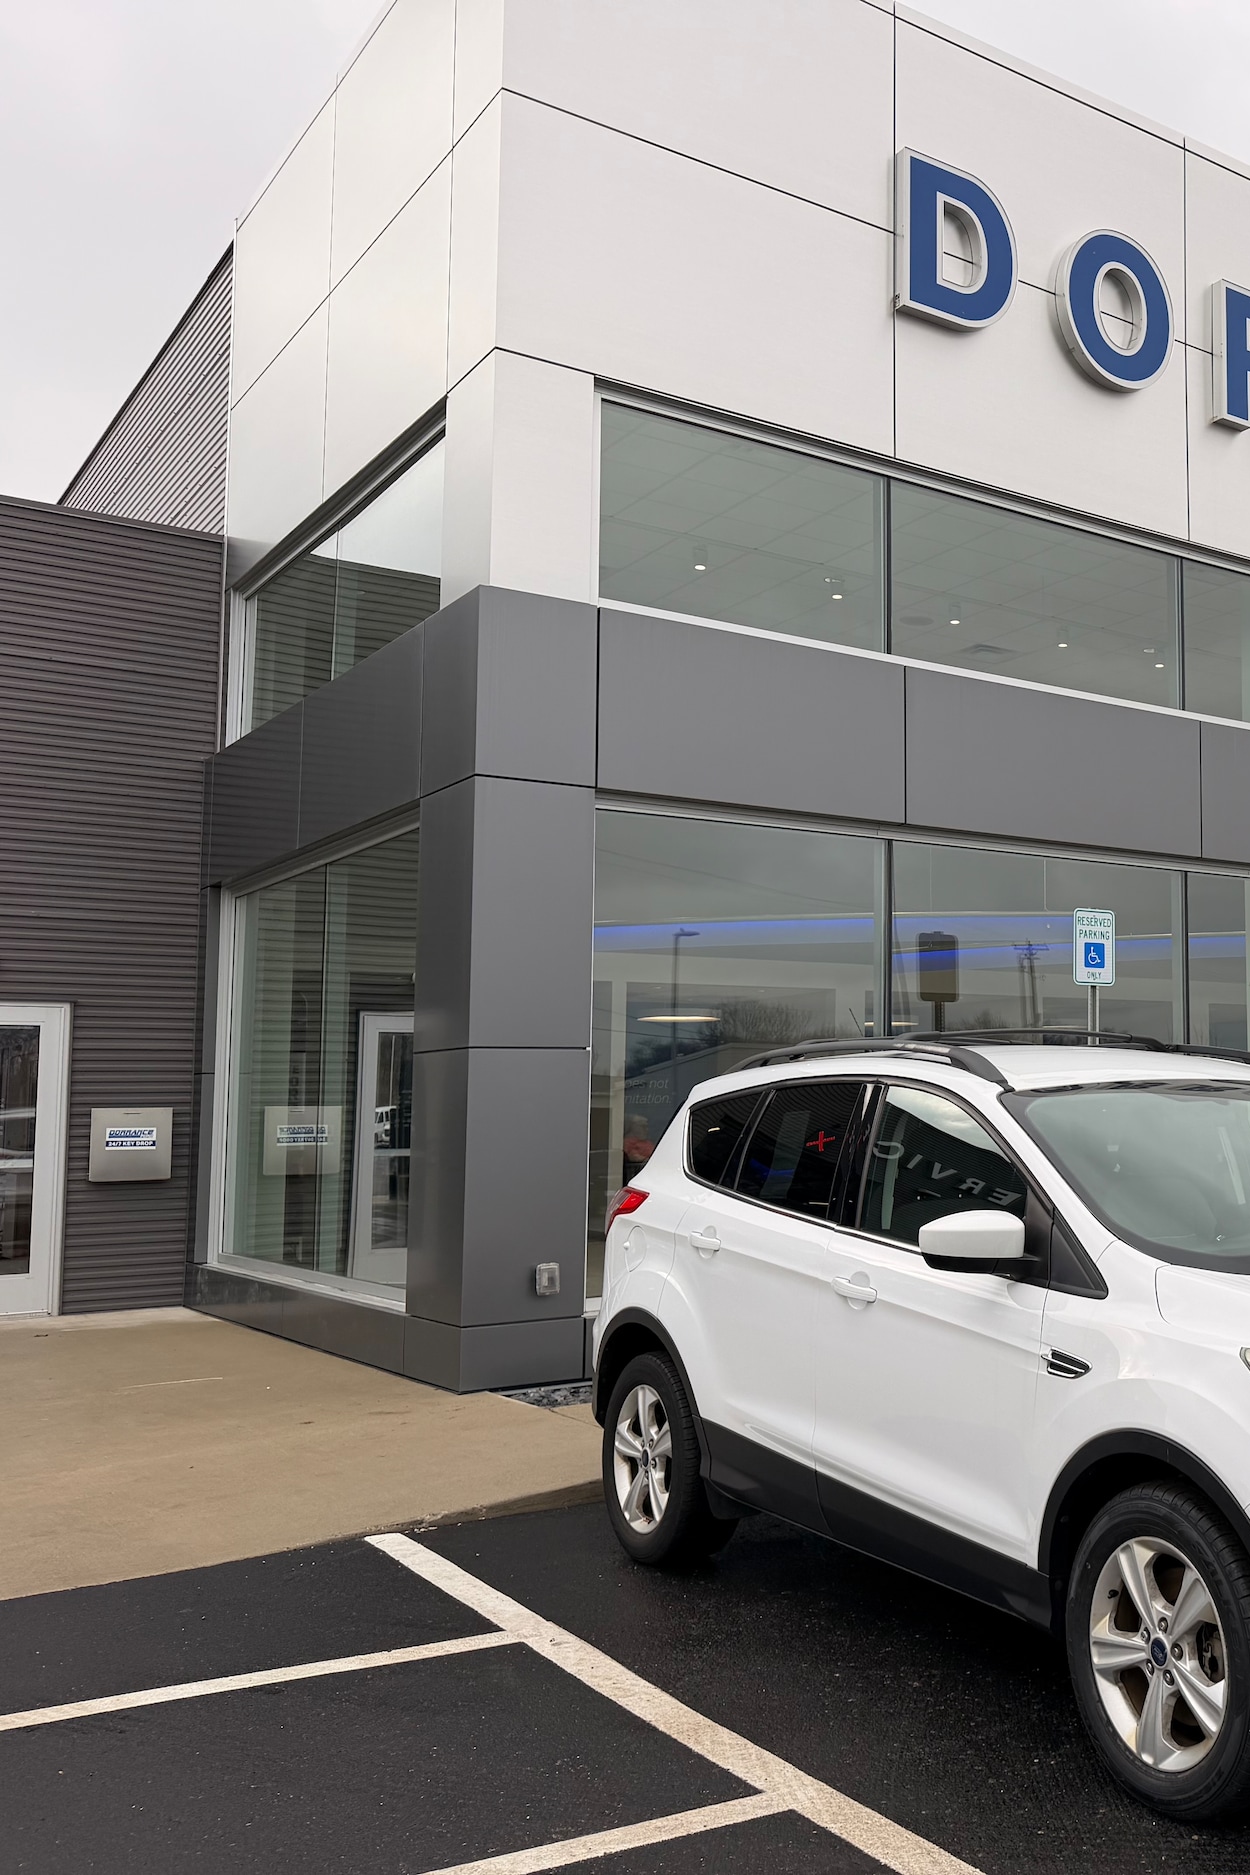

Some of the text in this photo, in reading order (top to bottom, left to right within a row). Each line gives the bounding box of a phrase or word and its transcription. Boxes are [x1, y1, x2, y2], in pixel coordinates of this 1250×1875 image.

[1077, 916, 1112, 928] RESERVED
[1078, 929, 1110, 940] PARKING
[1086, 971, 1102, 980] ONLY
[625, 1078, 670, 1089] oes not
